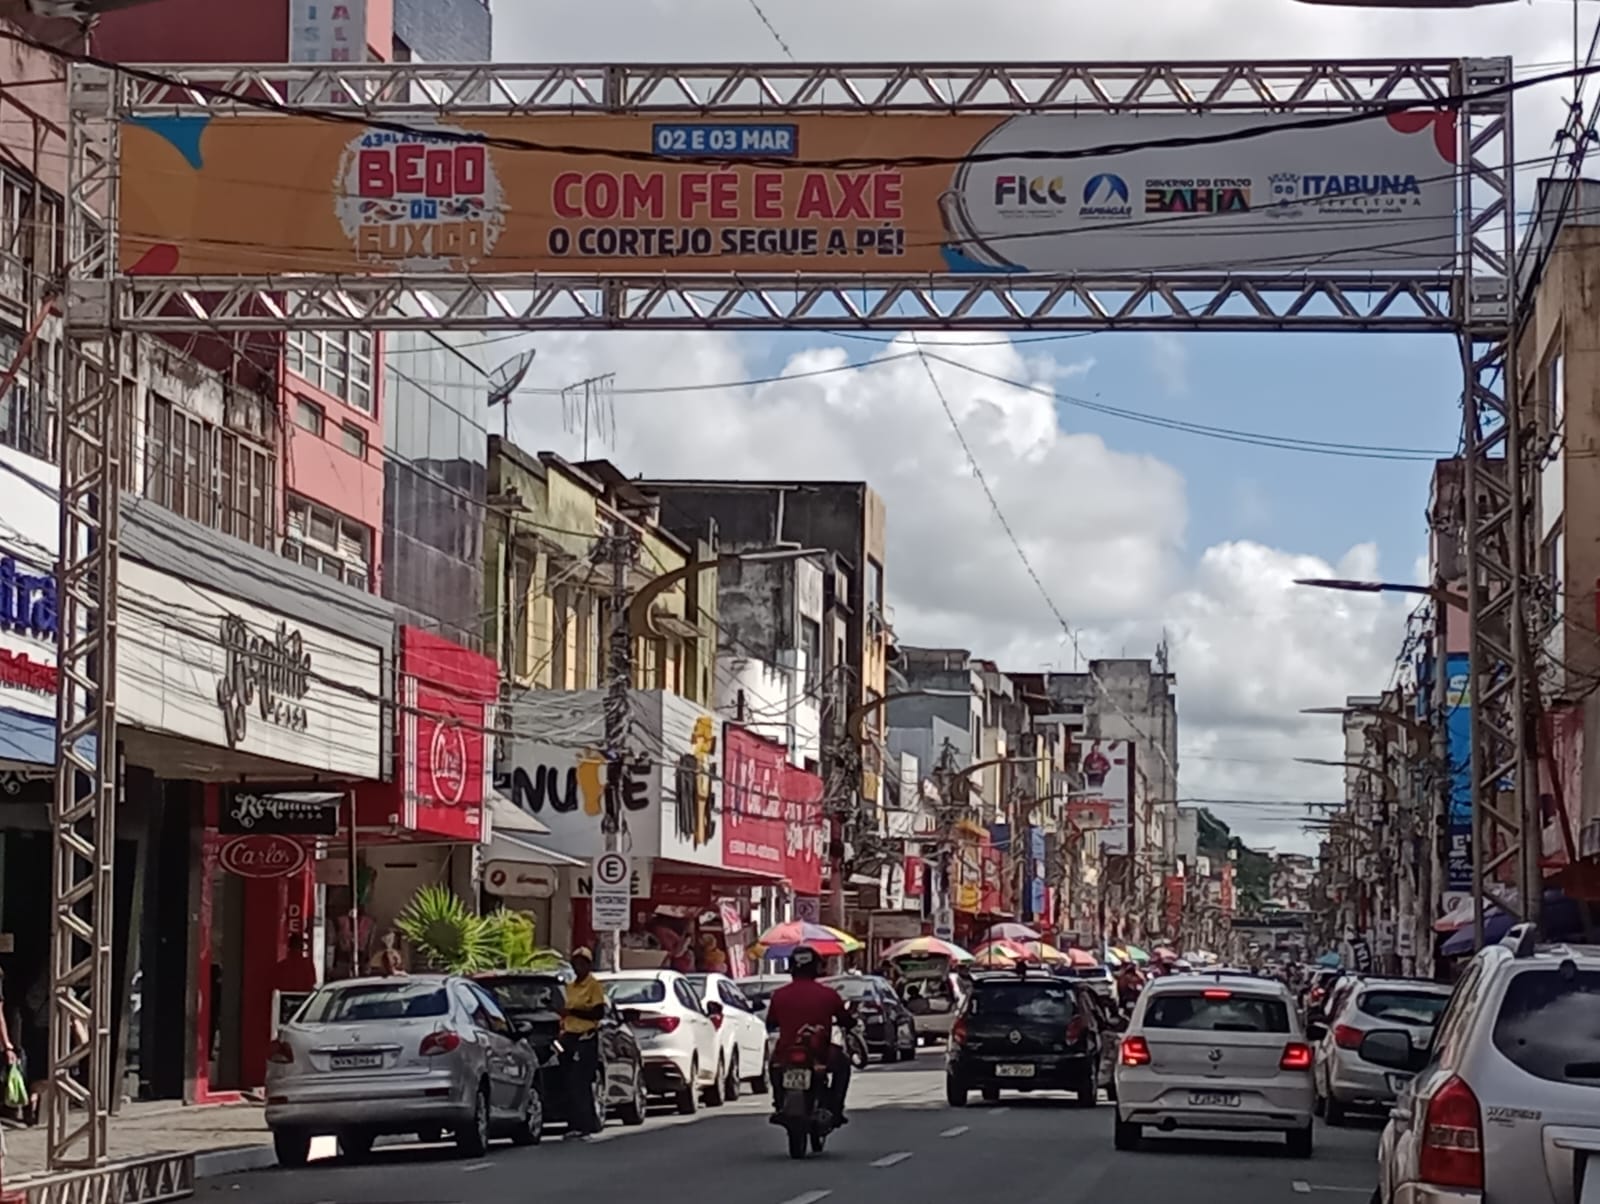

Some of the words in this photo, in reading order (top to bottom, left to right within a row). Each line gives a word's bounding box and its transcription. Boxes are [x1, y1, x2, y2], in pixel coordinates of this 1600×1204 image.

[658, 129, 687, 150] 02
[693, 129, 704, 150] E
[710, 129, 738, 150] 03
[742, 129, 790, 150] MAR
[553, 172, 664, 219] COM
[679, 163, 739, 219] FÉ
[754, 173, 783, 219] E
[797, 163, 902, 219] AXÉ
[1303, 175, 1421, 195] ITABUNA
[1145, 189, 1251, 212] BAHIA
[548, 228, 569, 256] O
[578, 228, 711, 256] CORTEJO
[720, 228, 817, 256] SEGUE
[827, 229, 846, 256] A
[856, 223, 905, 256] PÉ!
[606, 861, 618, 877] E
